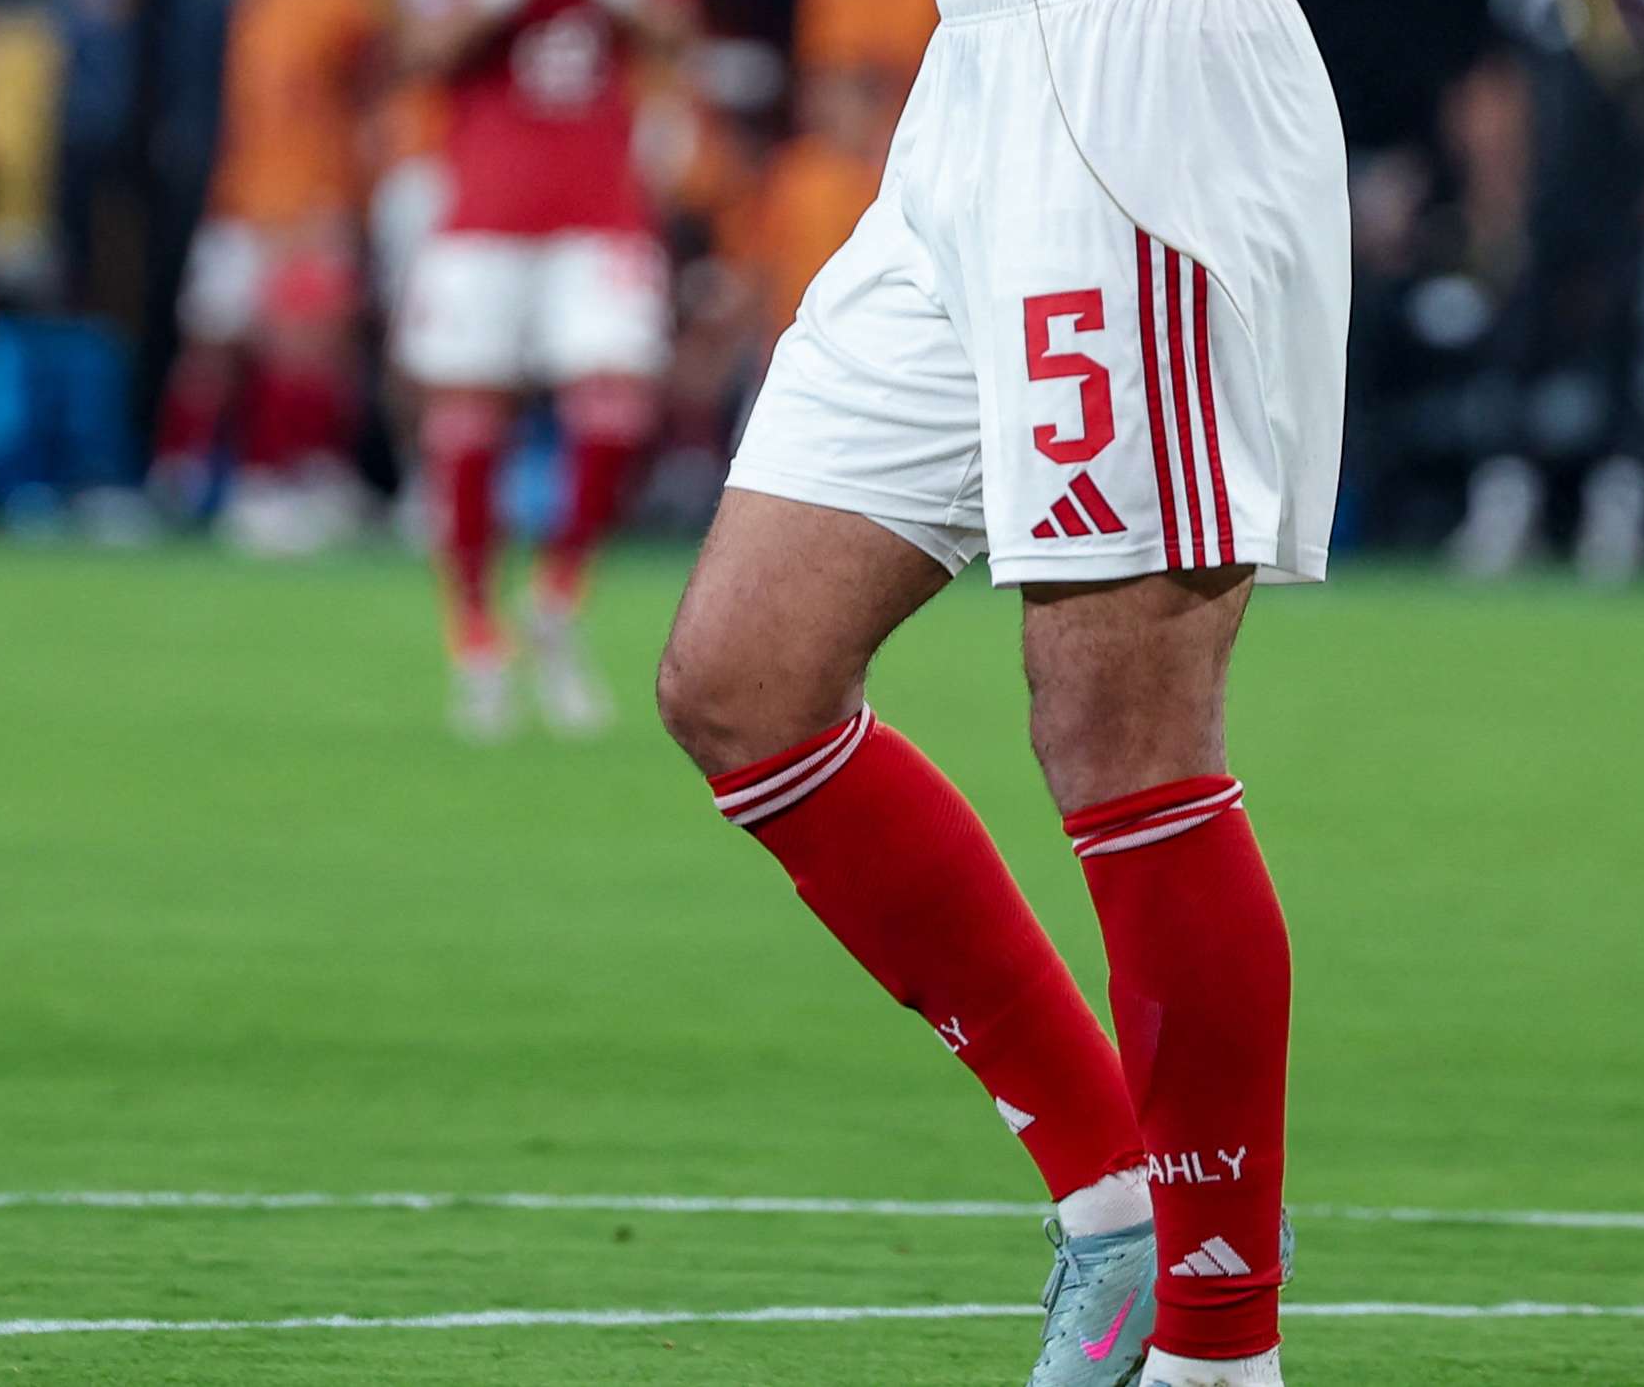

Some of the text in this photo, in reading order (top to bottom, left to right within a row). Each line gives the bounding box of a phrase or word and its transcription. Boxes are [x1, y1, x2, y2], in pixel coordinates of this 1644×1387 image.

[1023, 288, 1115, 464] 5
[934, 1015, 969, 1053] LY
[1147, 1144, 1246, 1185] AHLY
